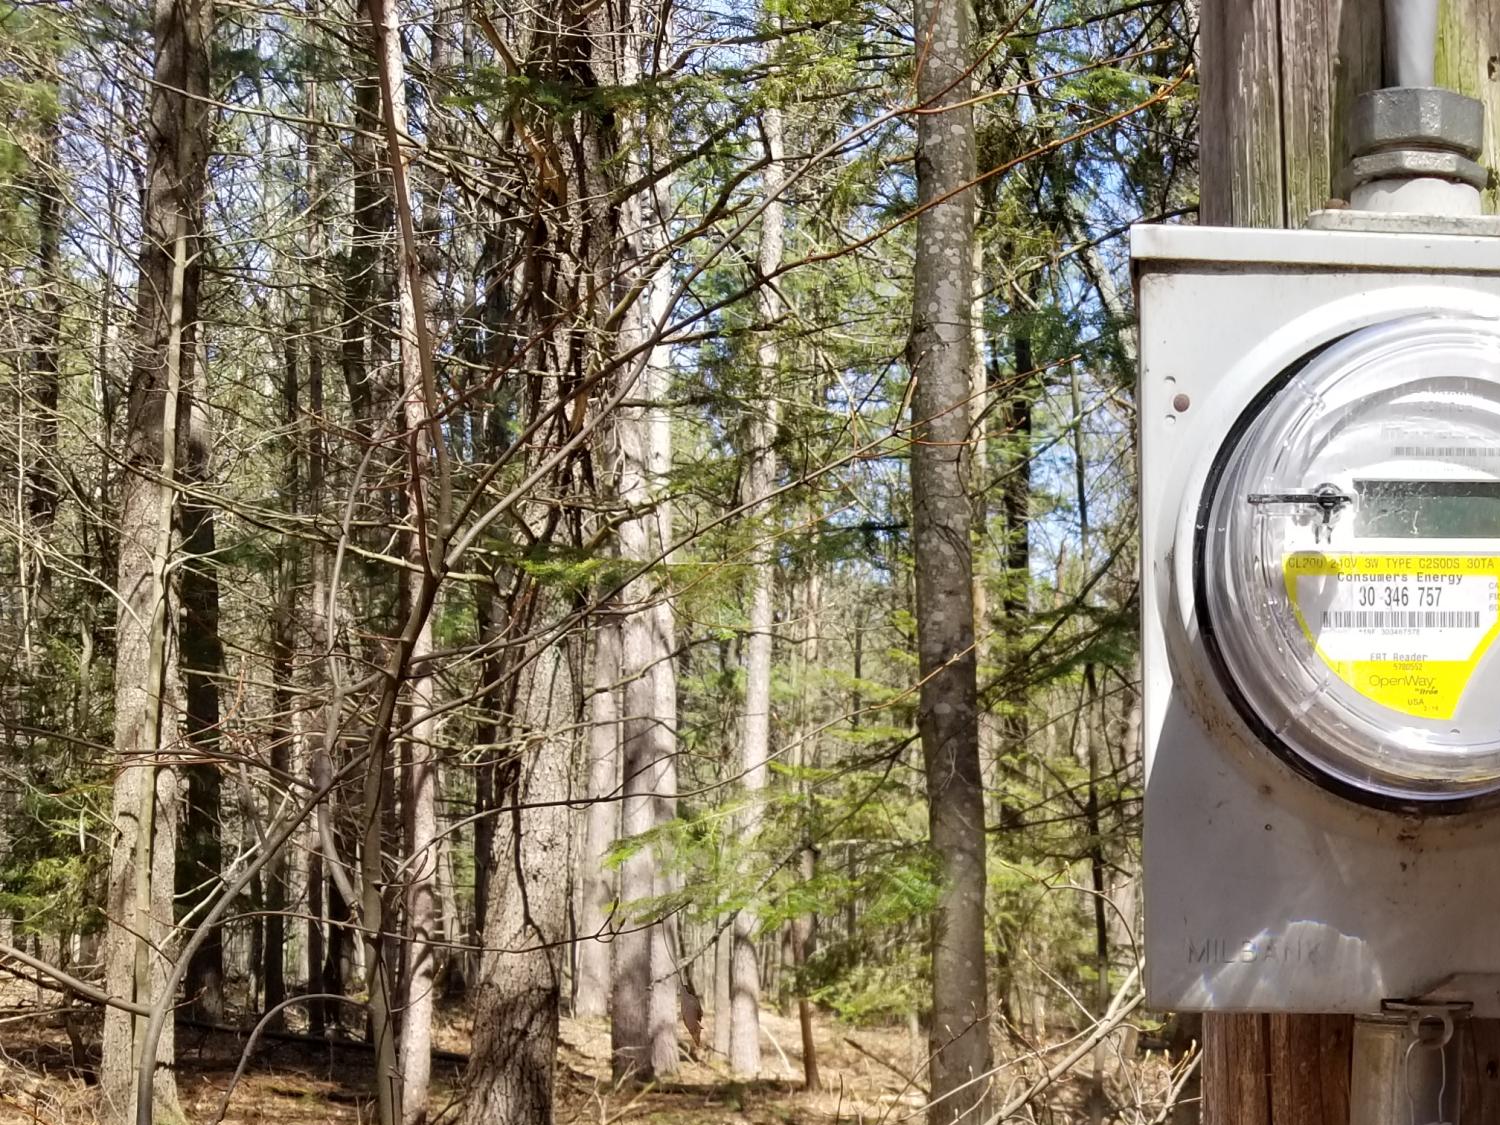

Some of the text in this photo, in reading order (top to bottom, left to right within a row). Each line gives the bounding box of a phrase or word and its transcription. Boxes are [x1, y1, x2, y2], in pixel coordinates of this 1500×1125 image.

[1364, 557, 1379, 569] 3W
[1386, 557, 1412, 569] TYPE
[1337, 571, 1463, 585] Consumers Energy
[1359, 587, 1442, 607] 30 346 757
[1392, 653, 1429, 663] Reader
[1368, 674, 1434, 688] OpenWay
[1187, 938, 1321, 964] MILBANK
